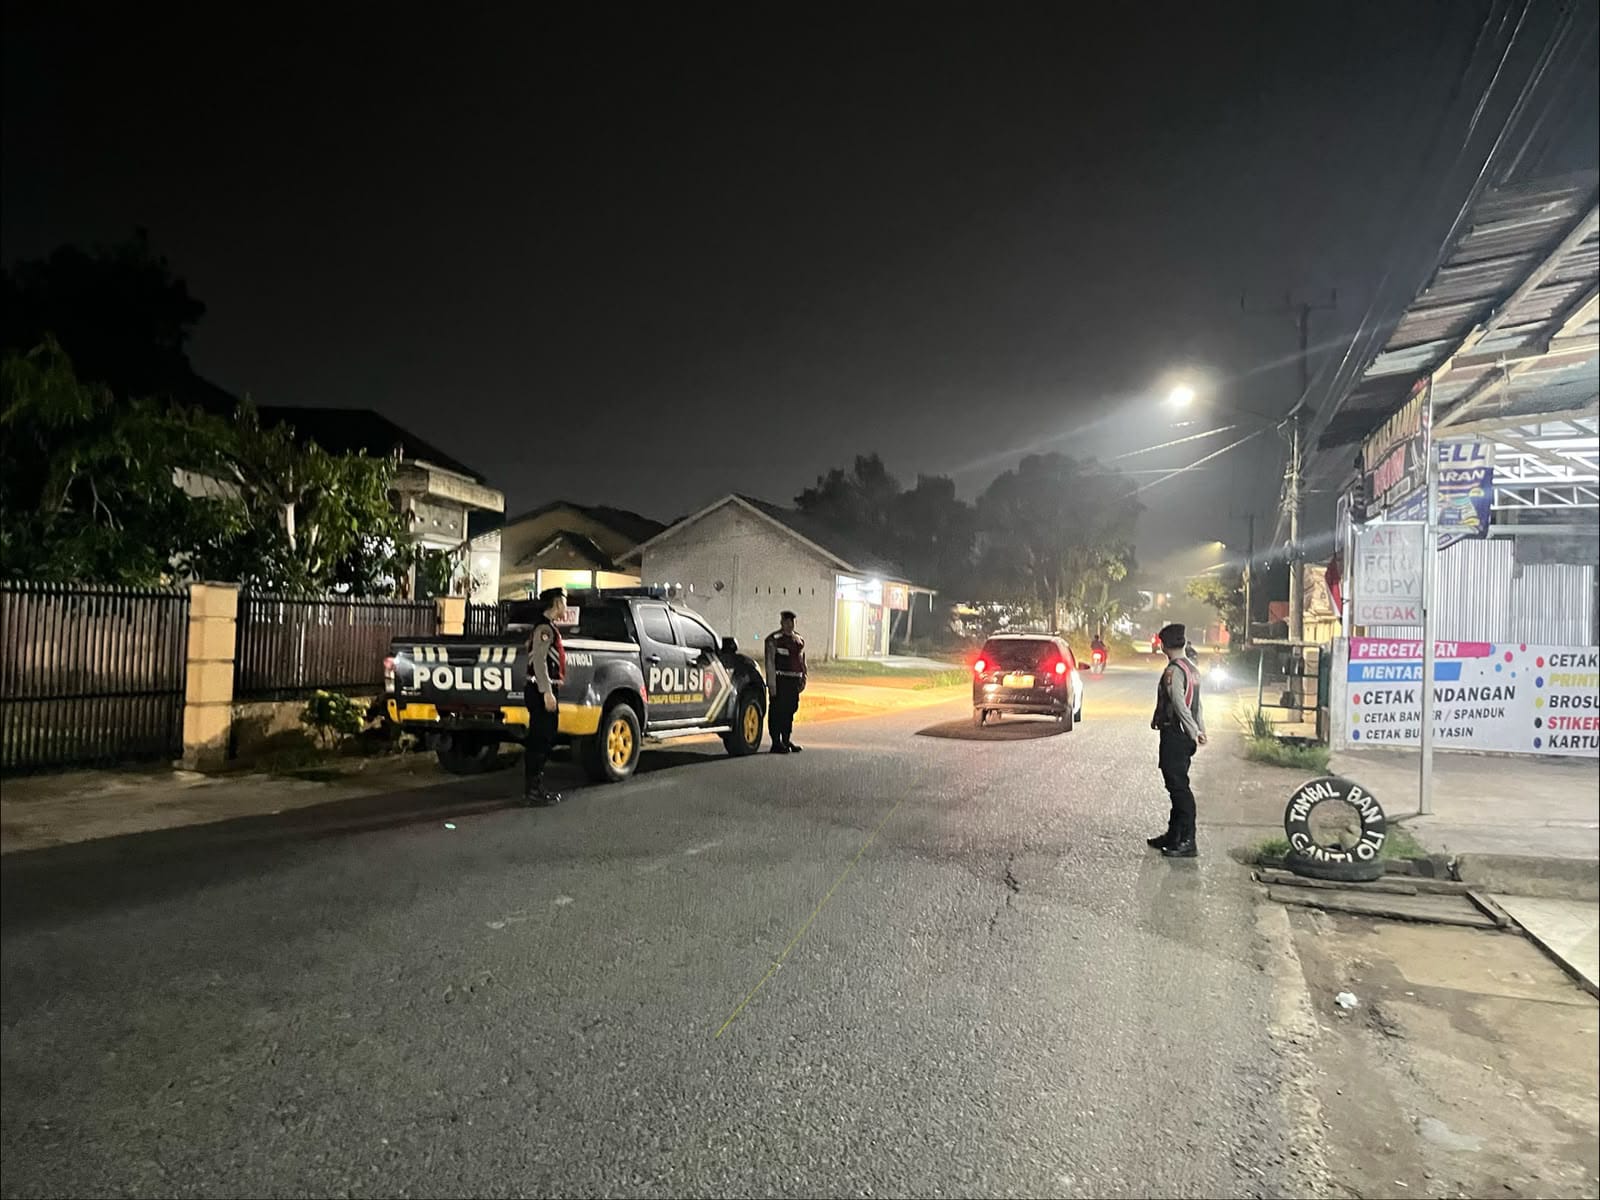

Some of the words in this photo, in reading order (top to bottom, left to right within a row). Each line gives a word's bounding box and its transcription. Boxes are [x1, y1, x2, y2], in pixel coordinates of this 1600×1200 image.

[1361, 607, 1416, 621] CETAK
[1358, 643, 1458, 657] PERCETAAN
[565, 652, 593, 667] ATROLI
[1549, 654, 1598, 668] CETAK
[413, 666, 513, 691] POLISI
[648, 666, 704, 693] POLISI
[1362, 666, 1424, 680] MENTAR
[1363, 690, 1415, 705] CETAK
[1432, 685, 1515, 703] NDANGAN
[1364, 712, 1396, 723] CETAK
[1399, 711, 1442, 722] BANR
[1454, 707, 1505, 720] SPANDUK
[1366, 729, 1401, 740] CETAK
[1439, 727, 1474, 738] YASIN
[1290, 781, 1340, 822] TAMBAL
[1346, 786, 1382, 824] BAN
